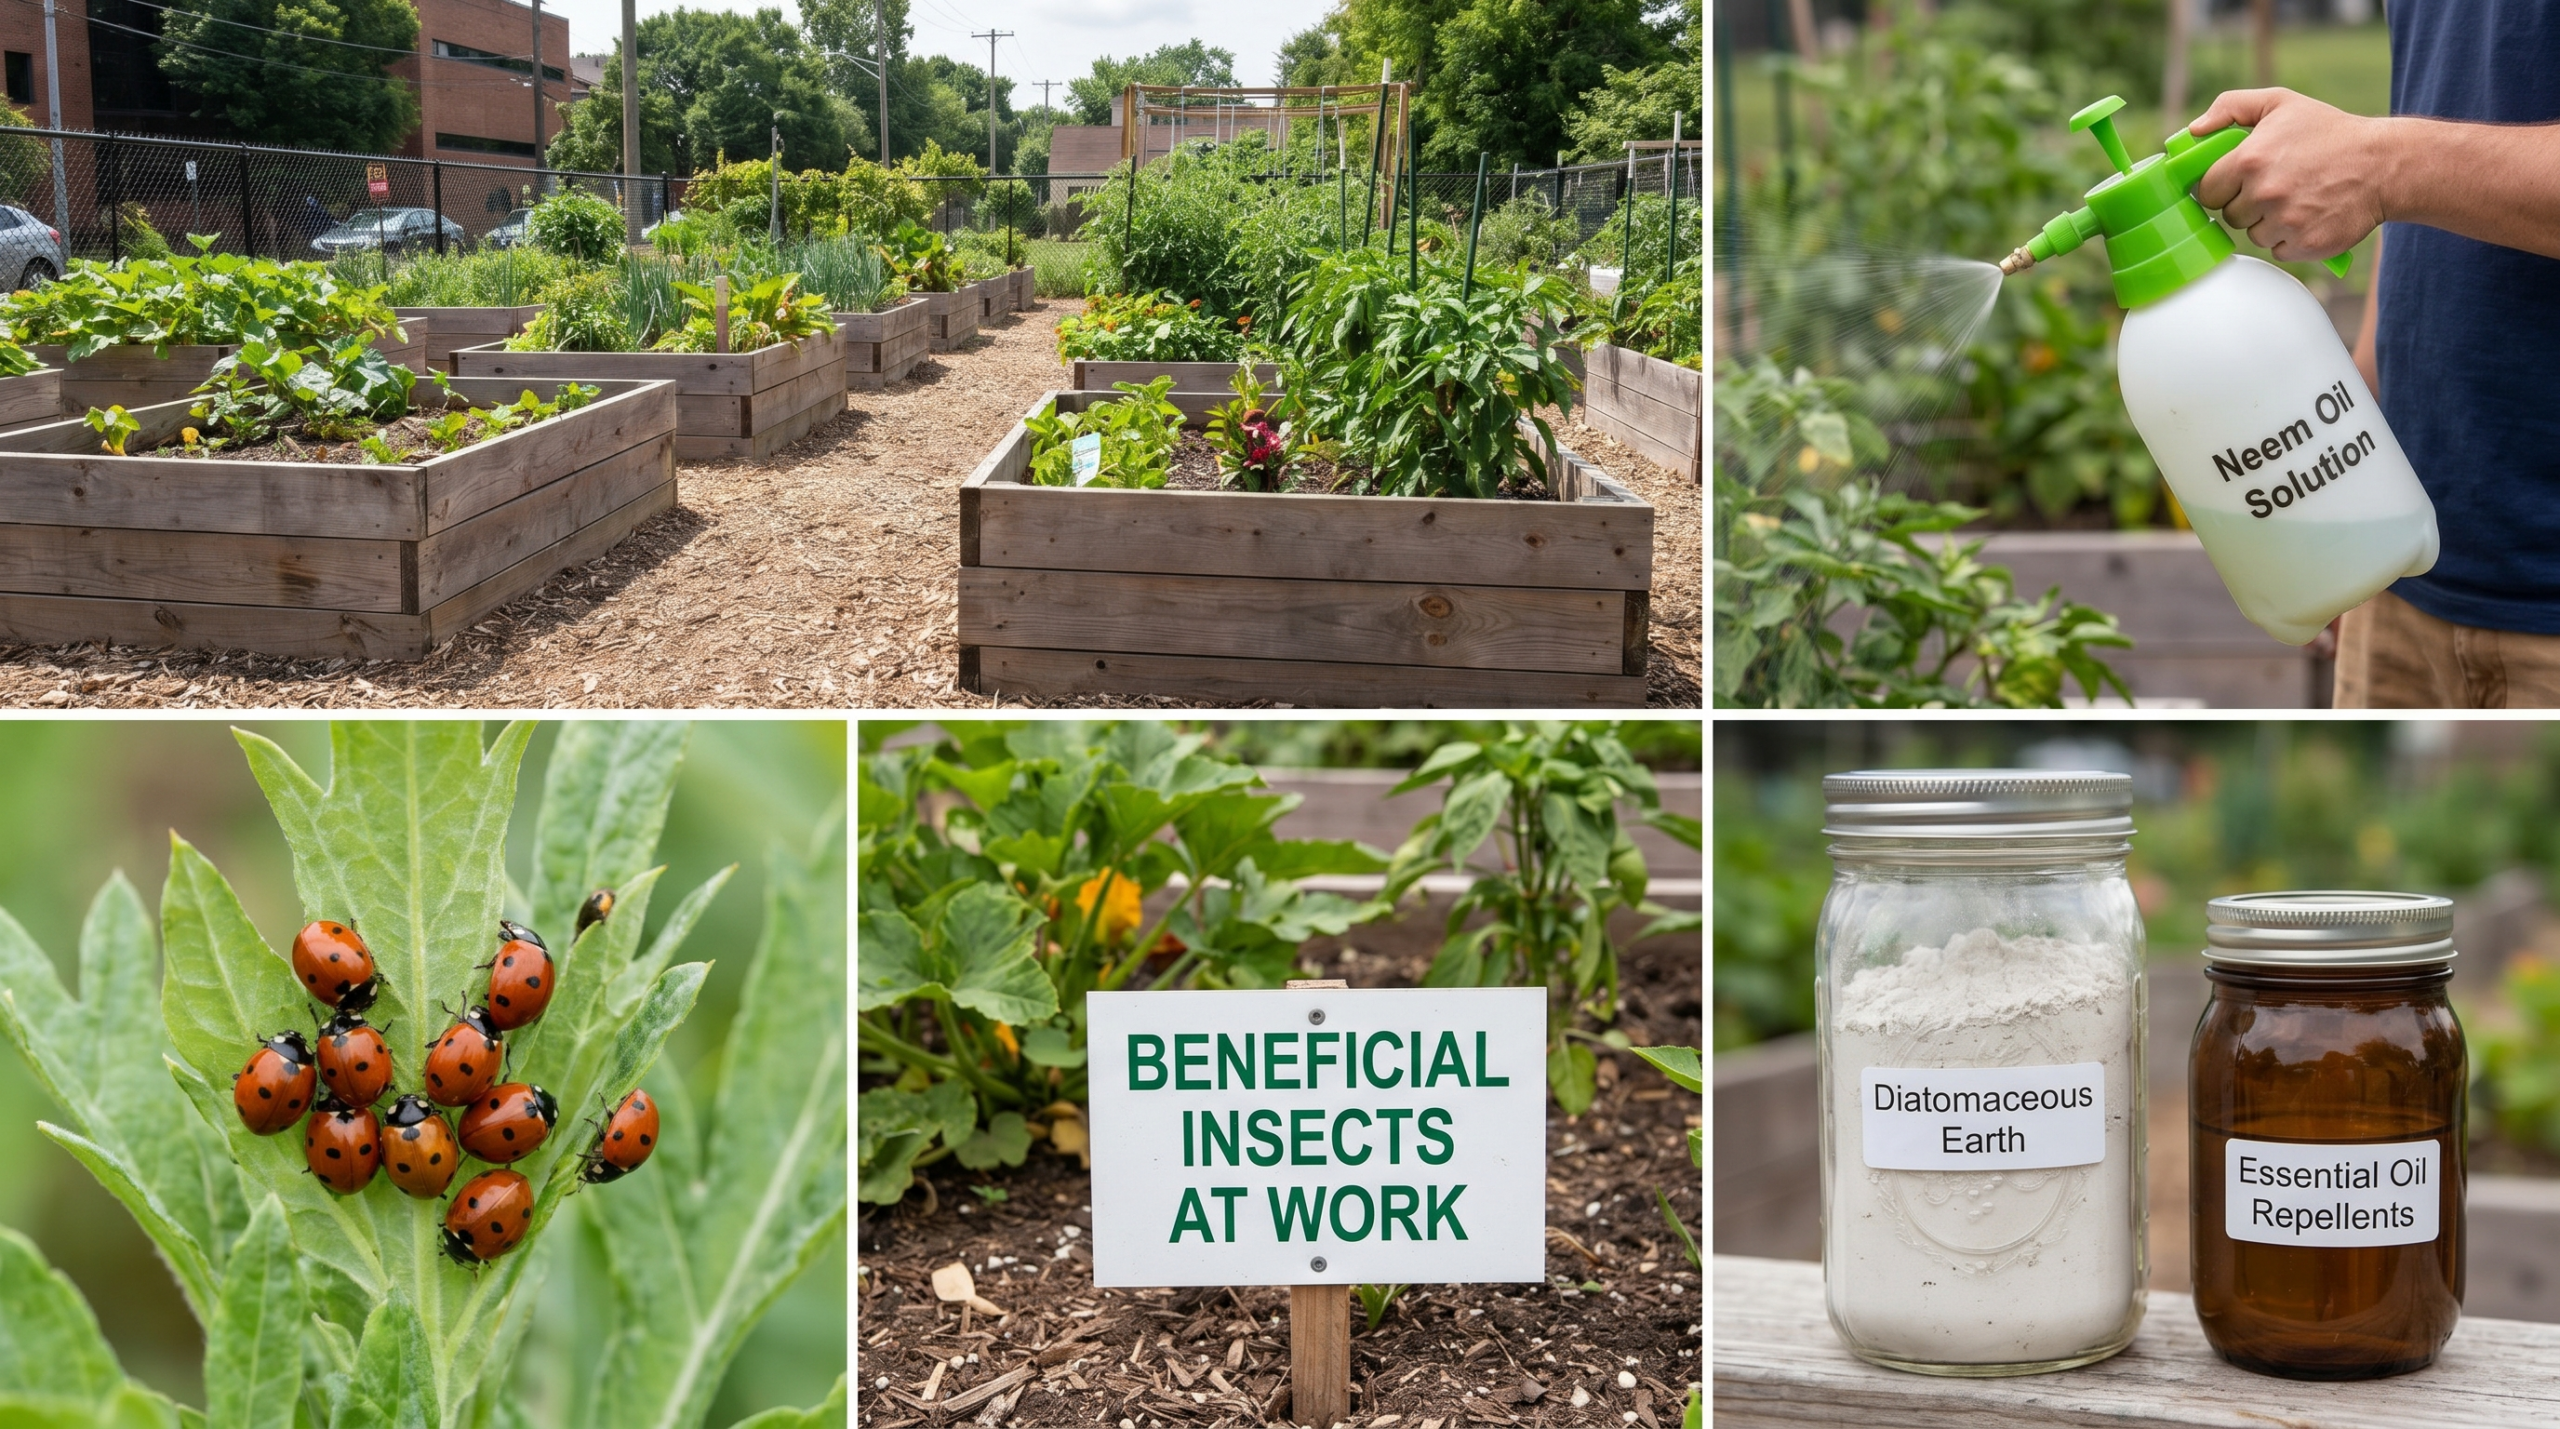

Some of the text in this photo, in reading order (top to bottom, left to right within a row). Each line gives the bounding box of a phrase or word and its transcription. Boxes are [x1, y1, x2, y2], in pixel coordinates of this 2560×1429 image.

[2211, 380, 2355, 483] Neem Oil
[2244, 430, 2376, 519] Solution
[1127, 1031, 1510, 1090] BENEFICIAL
[1874, 1083, 2093, 1113] Diatomaceous
[1183, 1108, 1455, 1166] INSECTS
[1942, 1125, 2025, 1154] Earth
[2240, 1155, 2426, 1189] Essential Oil
[1169, 1185, 1468, 1243] AT WORK
[2253, 1197, 2414, 1236] Repellents
